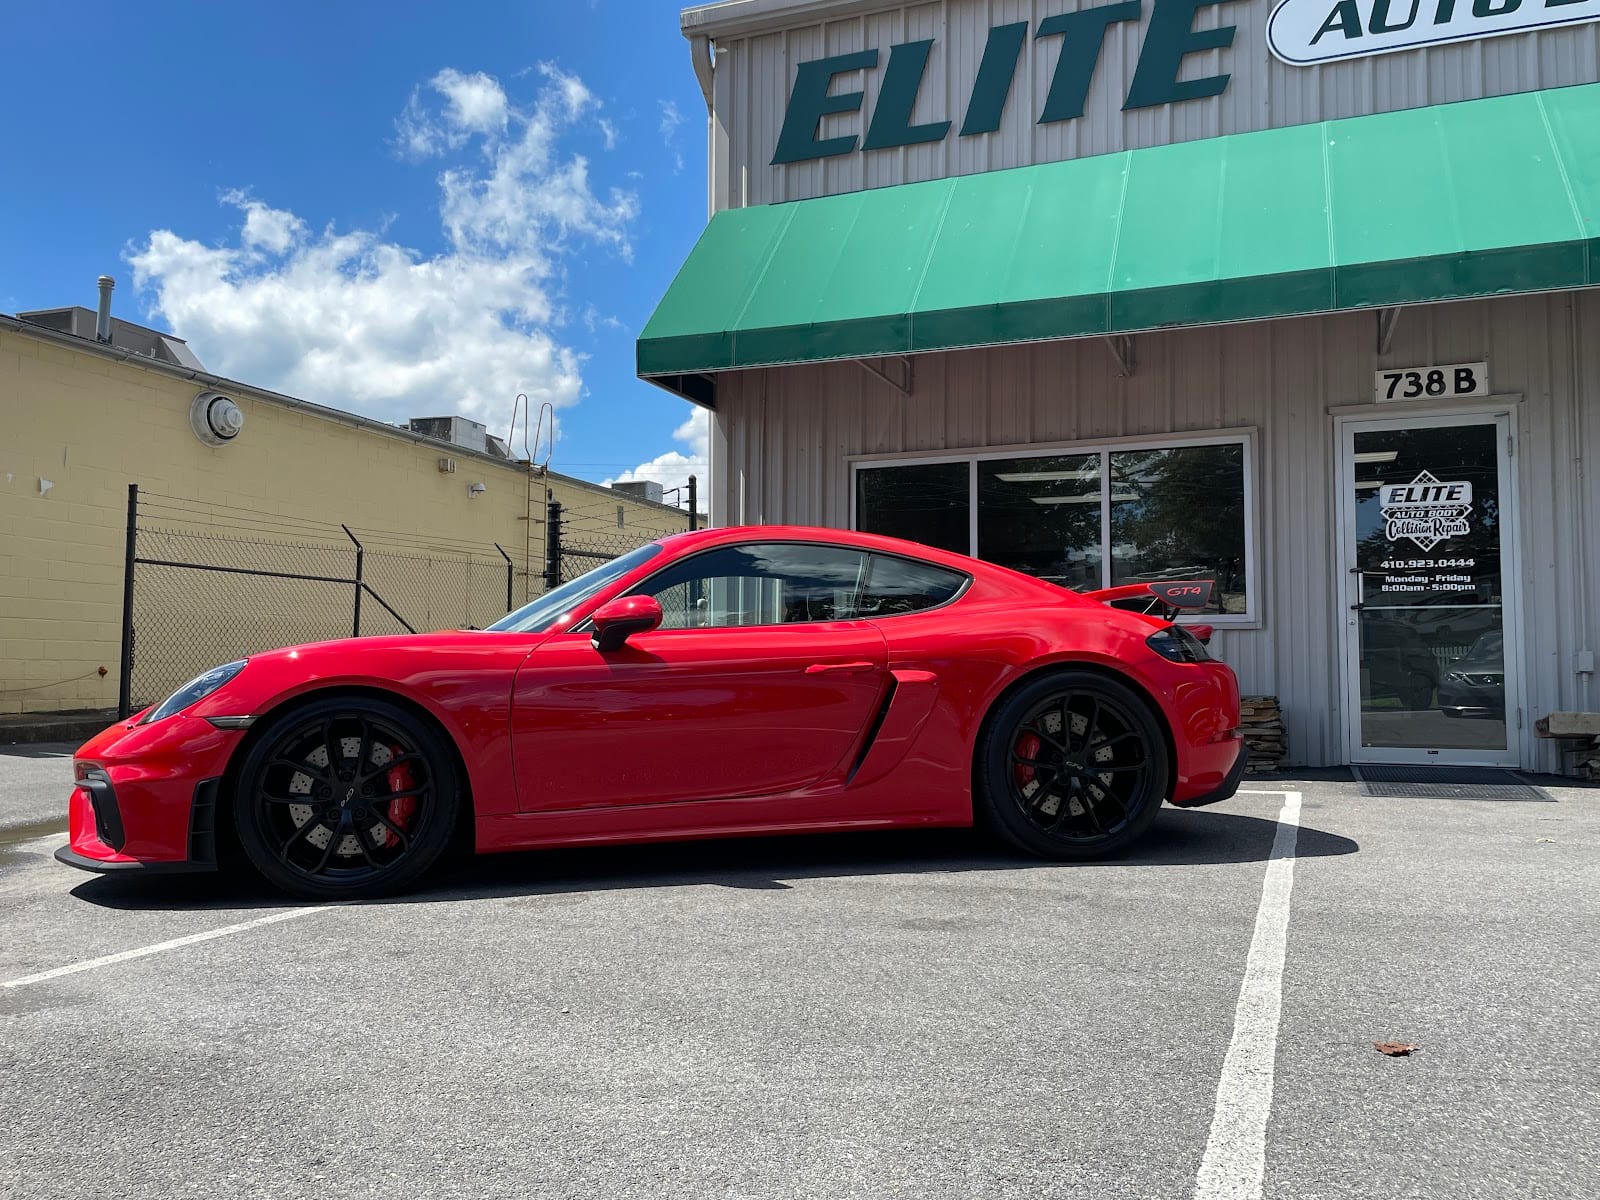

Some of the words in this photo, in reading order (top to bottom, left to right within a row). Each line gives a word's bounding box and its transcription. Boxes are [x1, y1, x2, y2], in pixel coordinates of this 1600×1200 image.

[769, 0, 1252, 166] ELITE
[1383, 370, 1446, 399] 738
[1454, 368, 1477, 394] B
[1388, 485, 1465, 504] ELITE
[1393, 510, 1425, 519] AUTO
[1428, 509, 1460, 517] BODY
[1388, 520, 1432, 539] Collision
[1431, 518, 1468, 536] Repair
[1380, 558, 1475, 568] 410.923.0444
[1385, 575, 1429, 583] Monday
[1435, 574, 1471, 582] Friday
[1166, 586, 1201, 596] GT4
[1381, 584, 1425, 592] 8:00am
[1431, 583, 1476, 591] 5:00pm
